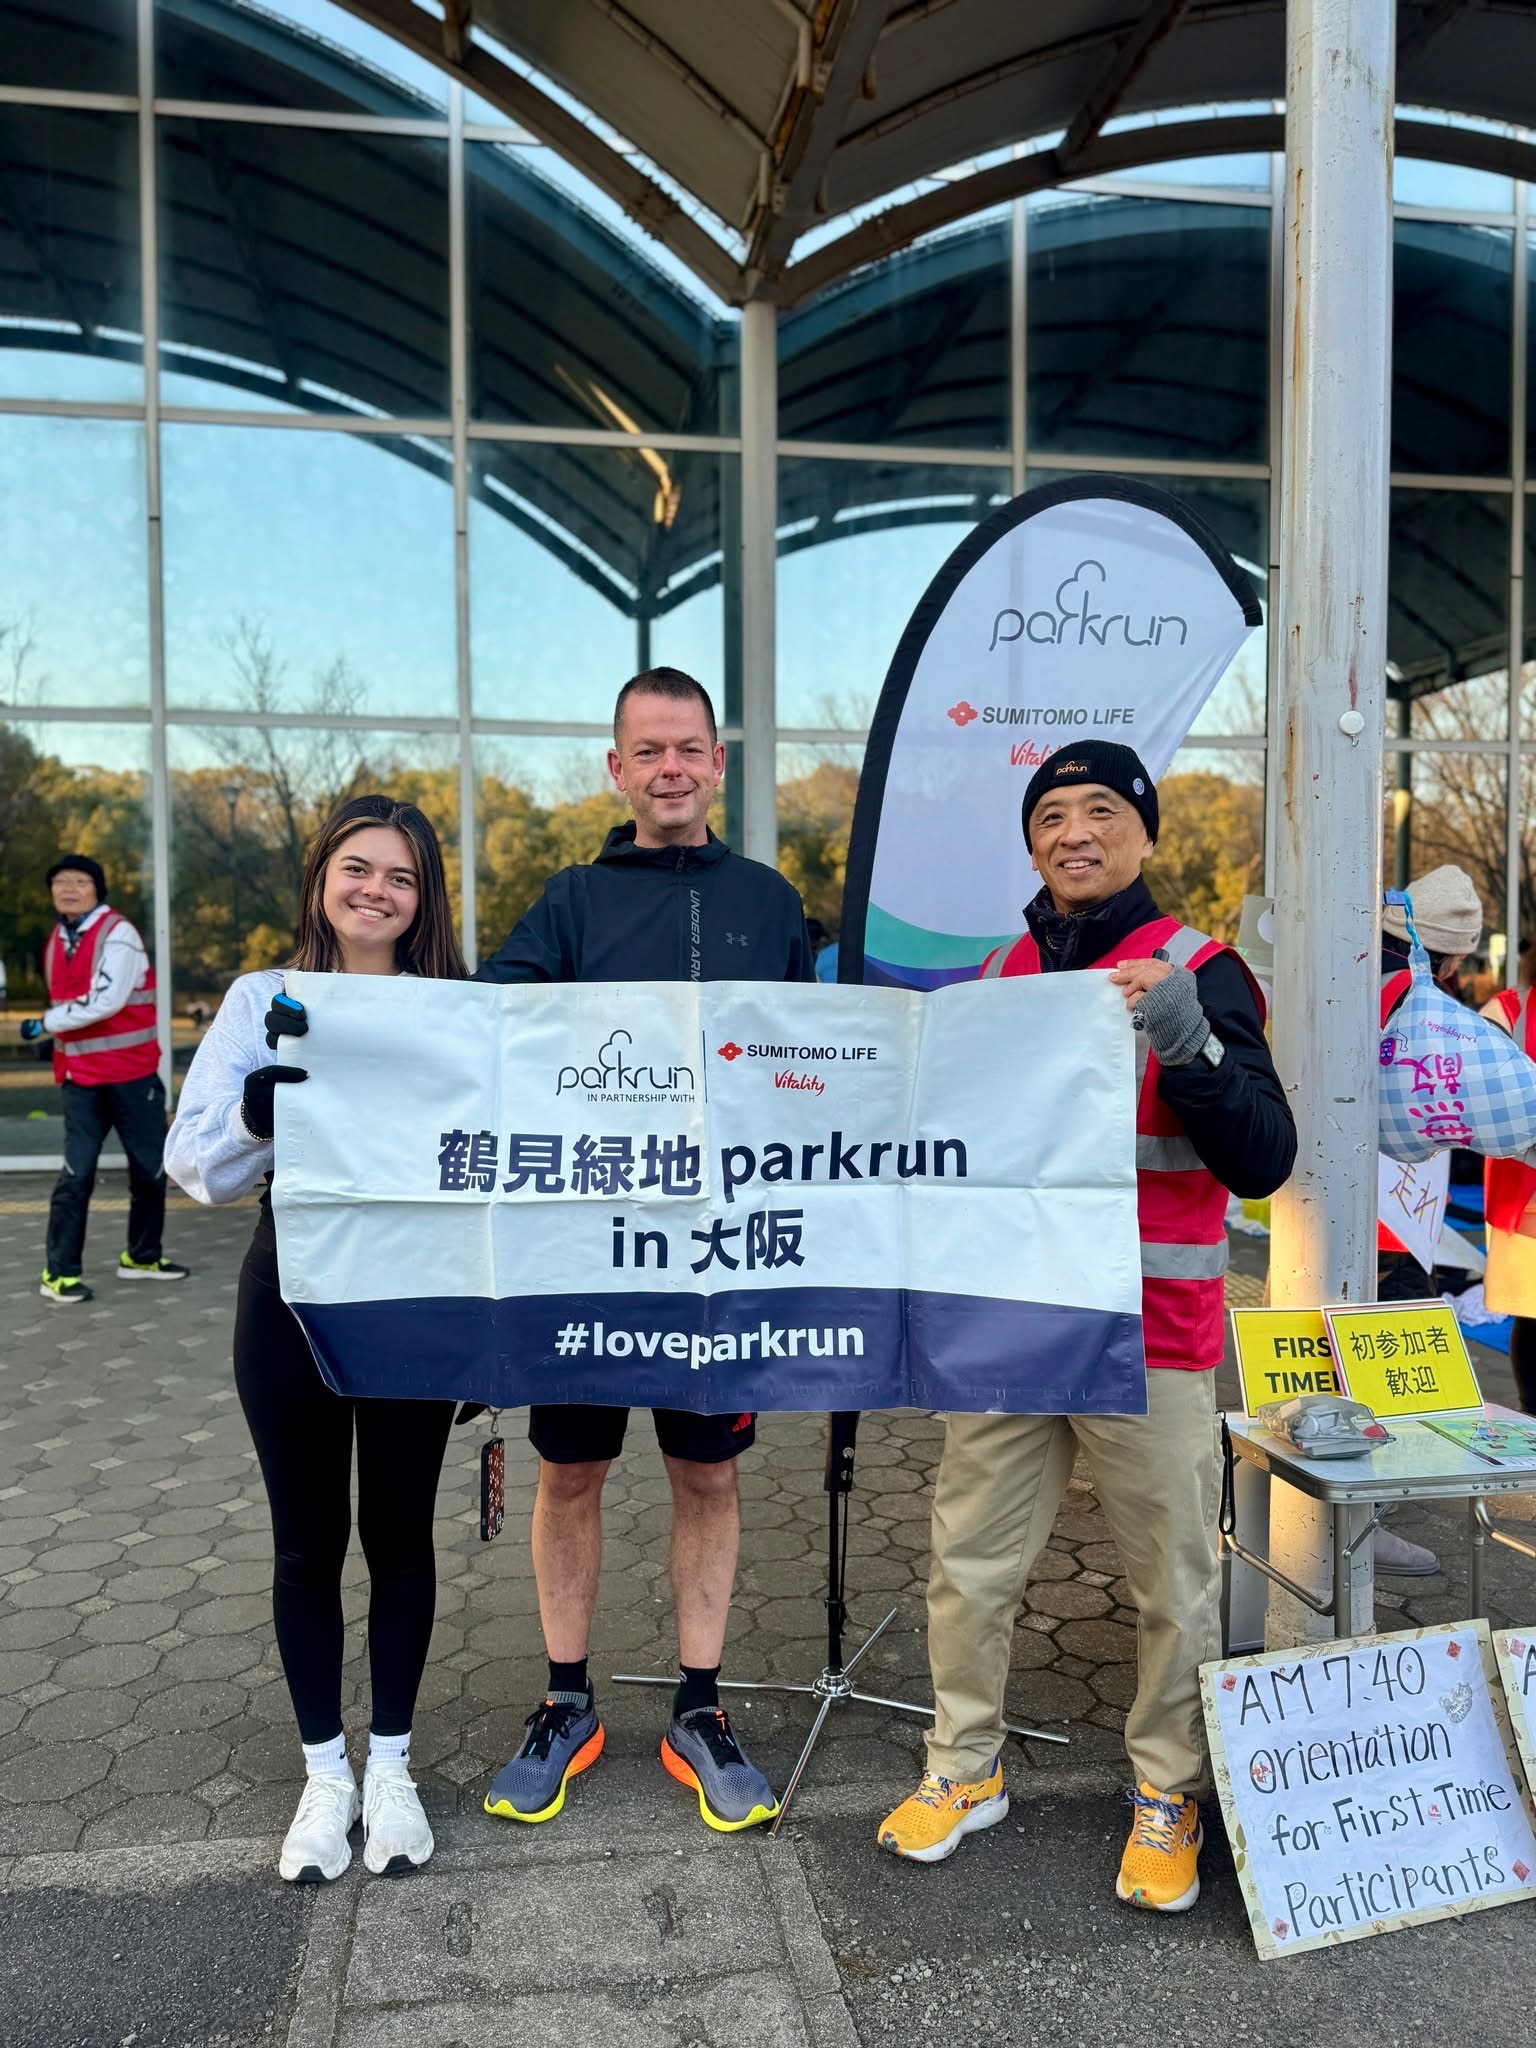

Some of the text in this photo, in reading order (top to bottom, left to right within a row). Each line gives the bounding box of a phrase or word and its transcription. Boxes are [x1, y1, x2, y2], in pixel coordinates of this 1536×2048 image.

[989, 559, 1188, 652] parkrun
[981, 705, 1135, 725] SUMITOMO LIFE
[1009, 739, 1063, 766] Vital
[1056, 760, 1088, 776] parkrun
[689, 888, 701, 982] UNDER ARM
[555, 1029, 695, 1096] parkrun
[747, 1044, 878, 1060] SUMITOMO LIFE
[587, 1093, 695, 1103] IN PARTNERSHIP WITH
[774, 1068, 826, 1097] Vitality
[437, 1129, 969, 1203] 鶴見緑地 parkrun
[611, 1208, 806, 1274] in 大阪
[554, 1320, 864, 1371] #loveparkrun
[1273, 1336, 1332, 1359] FIRS
[1349, 1325, 1450, 1362] 初参加者
[1385, 1366, 1440, 1398] 歓迎
[1240, 1646, 1426, 1726] AM 7:40
[1249, 1722, 1453, 1794] Orientation
[1271, 1782, 1512, 1856] for First Time
[1284, 1845, 1507, 1937] Participants
